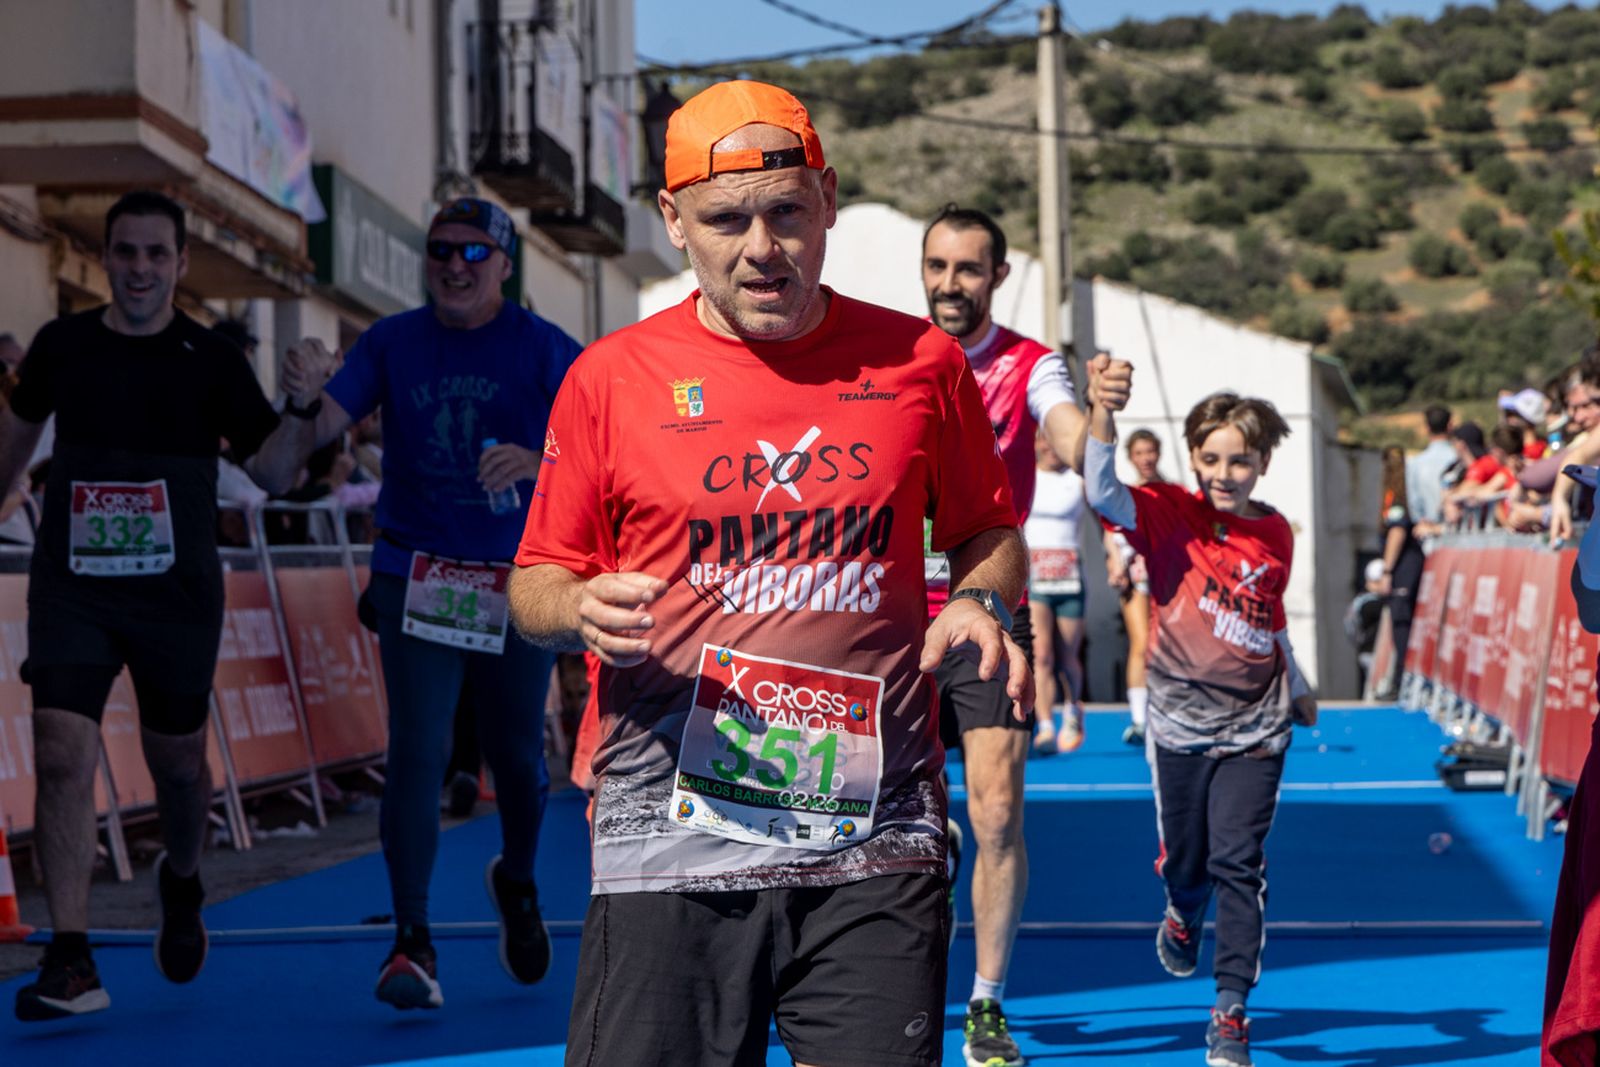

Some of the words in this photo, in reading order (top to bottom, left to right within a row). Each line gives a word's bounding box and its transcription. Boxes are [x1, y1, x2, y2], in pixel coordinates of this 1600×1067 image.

[837, 391, 898, 402] TEAMERGY
[703, 442, 873, 494] CROSS
[87, 515, 154, 547] 332
[688, 504, 895, 568] PANTANO
[434, 586, 479, 619] 34
[719, 553, 885, 615] VÍBORAS
[723, 662, 750, 700] X
[752, 680, 847, 718] CROSS
[717, 696, 827, 735] PANTANO
[711, 718, 838, 796] 351
[678, 775, 731, 797] CARLOS
